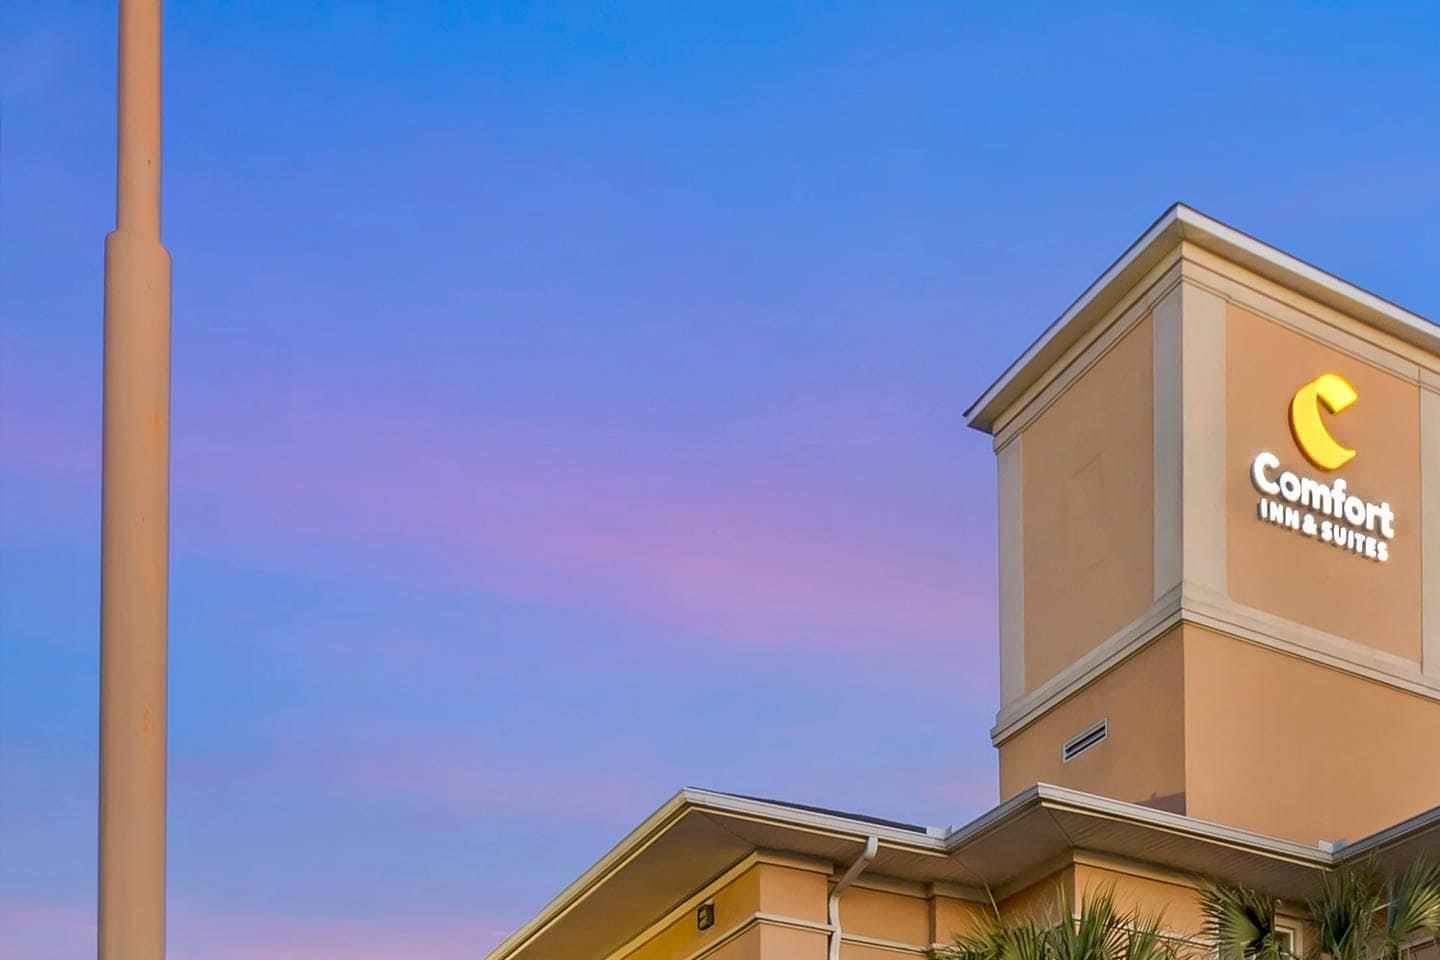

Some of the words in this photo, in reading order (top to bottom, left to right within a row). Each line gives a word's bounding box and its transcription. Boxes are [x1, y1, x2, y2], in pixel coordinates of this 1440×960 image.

[1251, 451, 1395, 539] Comfort
[1259, 498, 1301, 530] INN
[1302, 513, 1318, 537] &
[1320, 520, 1389, 563] SUITES
